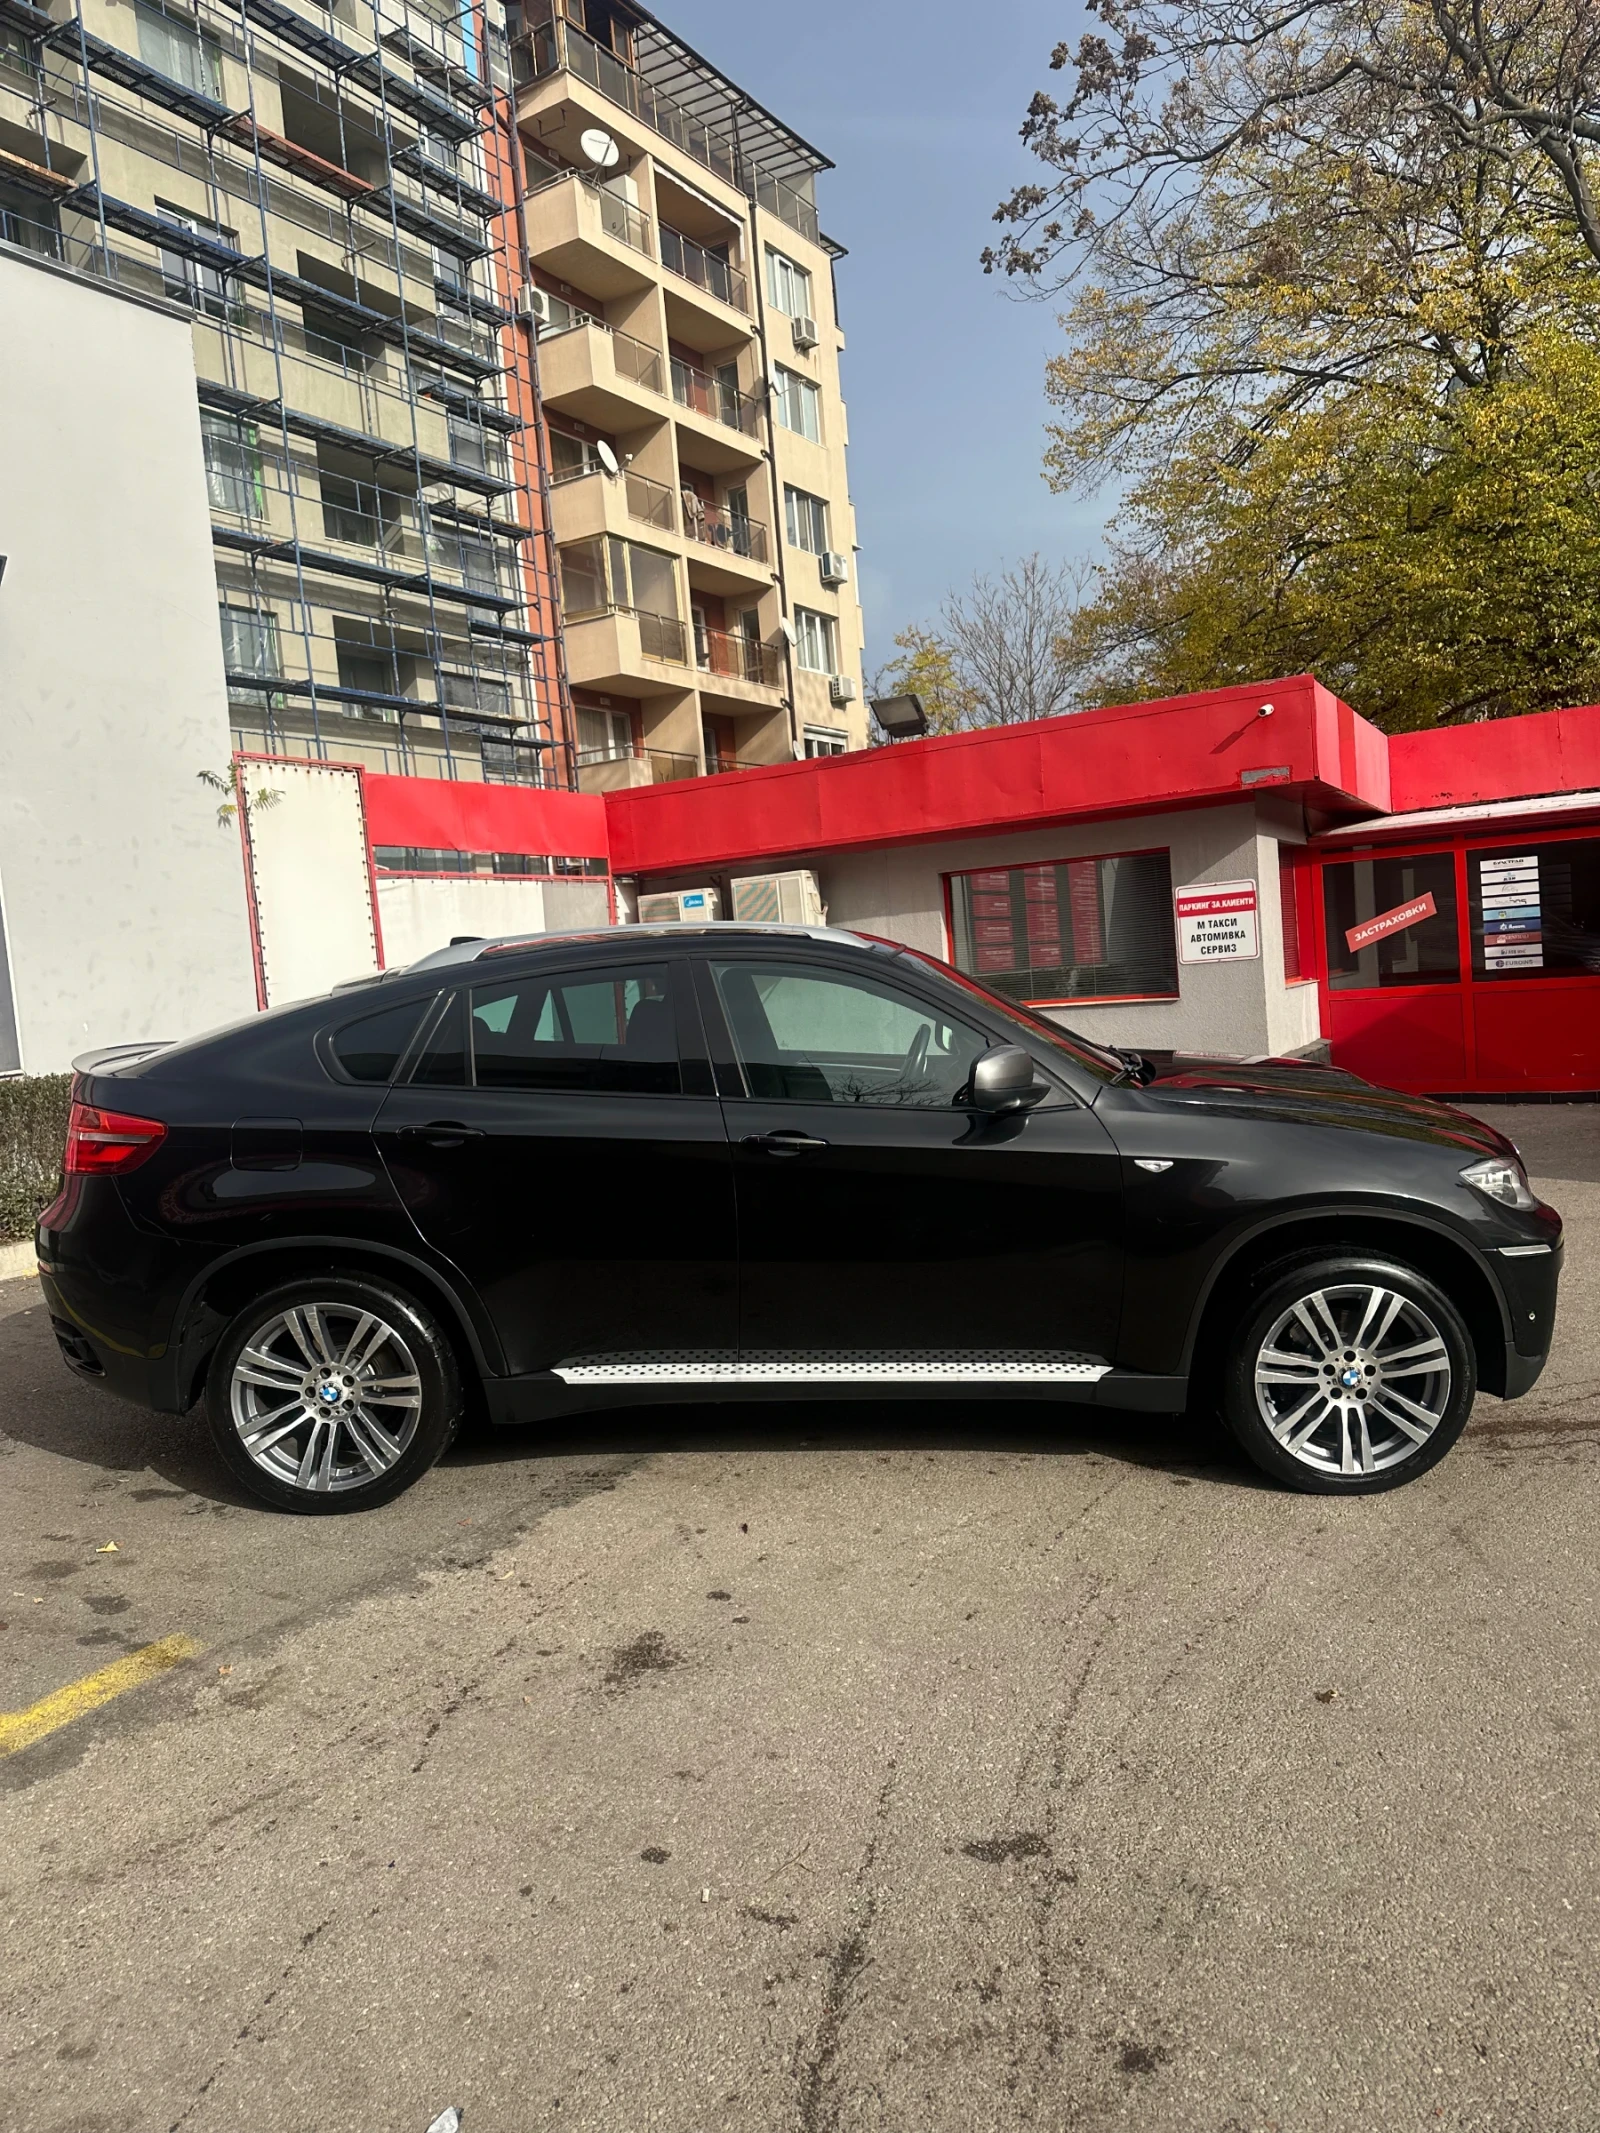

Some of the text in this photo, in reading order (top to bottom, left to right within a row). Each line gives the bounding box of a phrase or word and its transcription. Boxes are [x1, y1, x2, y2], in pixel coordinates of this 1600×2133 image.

[1178, 897, 1254, 911] ПАРКИНГ ЗА КЛИЕНТИ
[1197, 918, 1238, 930] М ТАКСИ
[1354, 902, 1427, 942] ЗАСТРАХОВКИ
[1190, 930, 1246, 943] АВТОМИВКА
[1200, 943, 1237, 955] СЕРВИЗ
